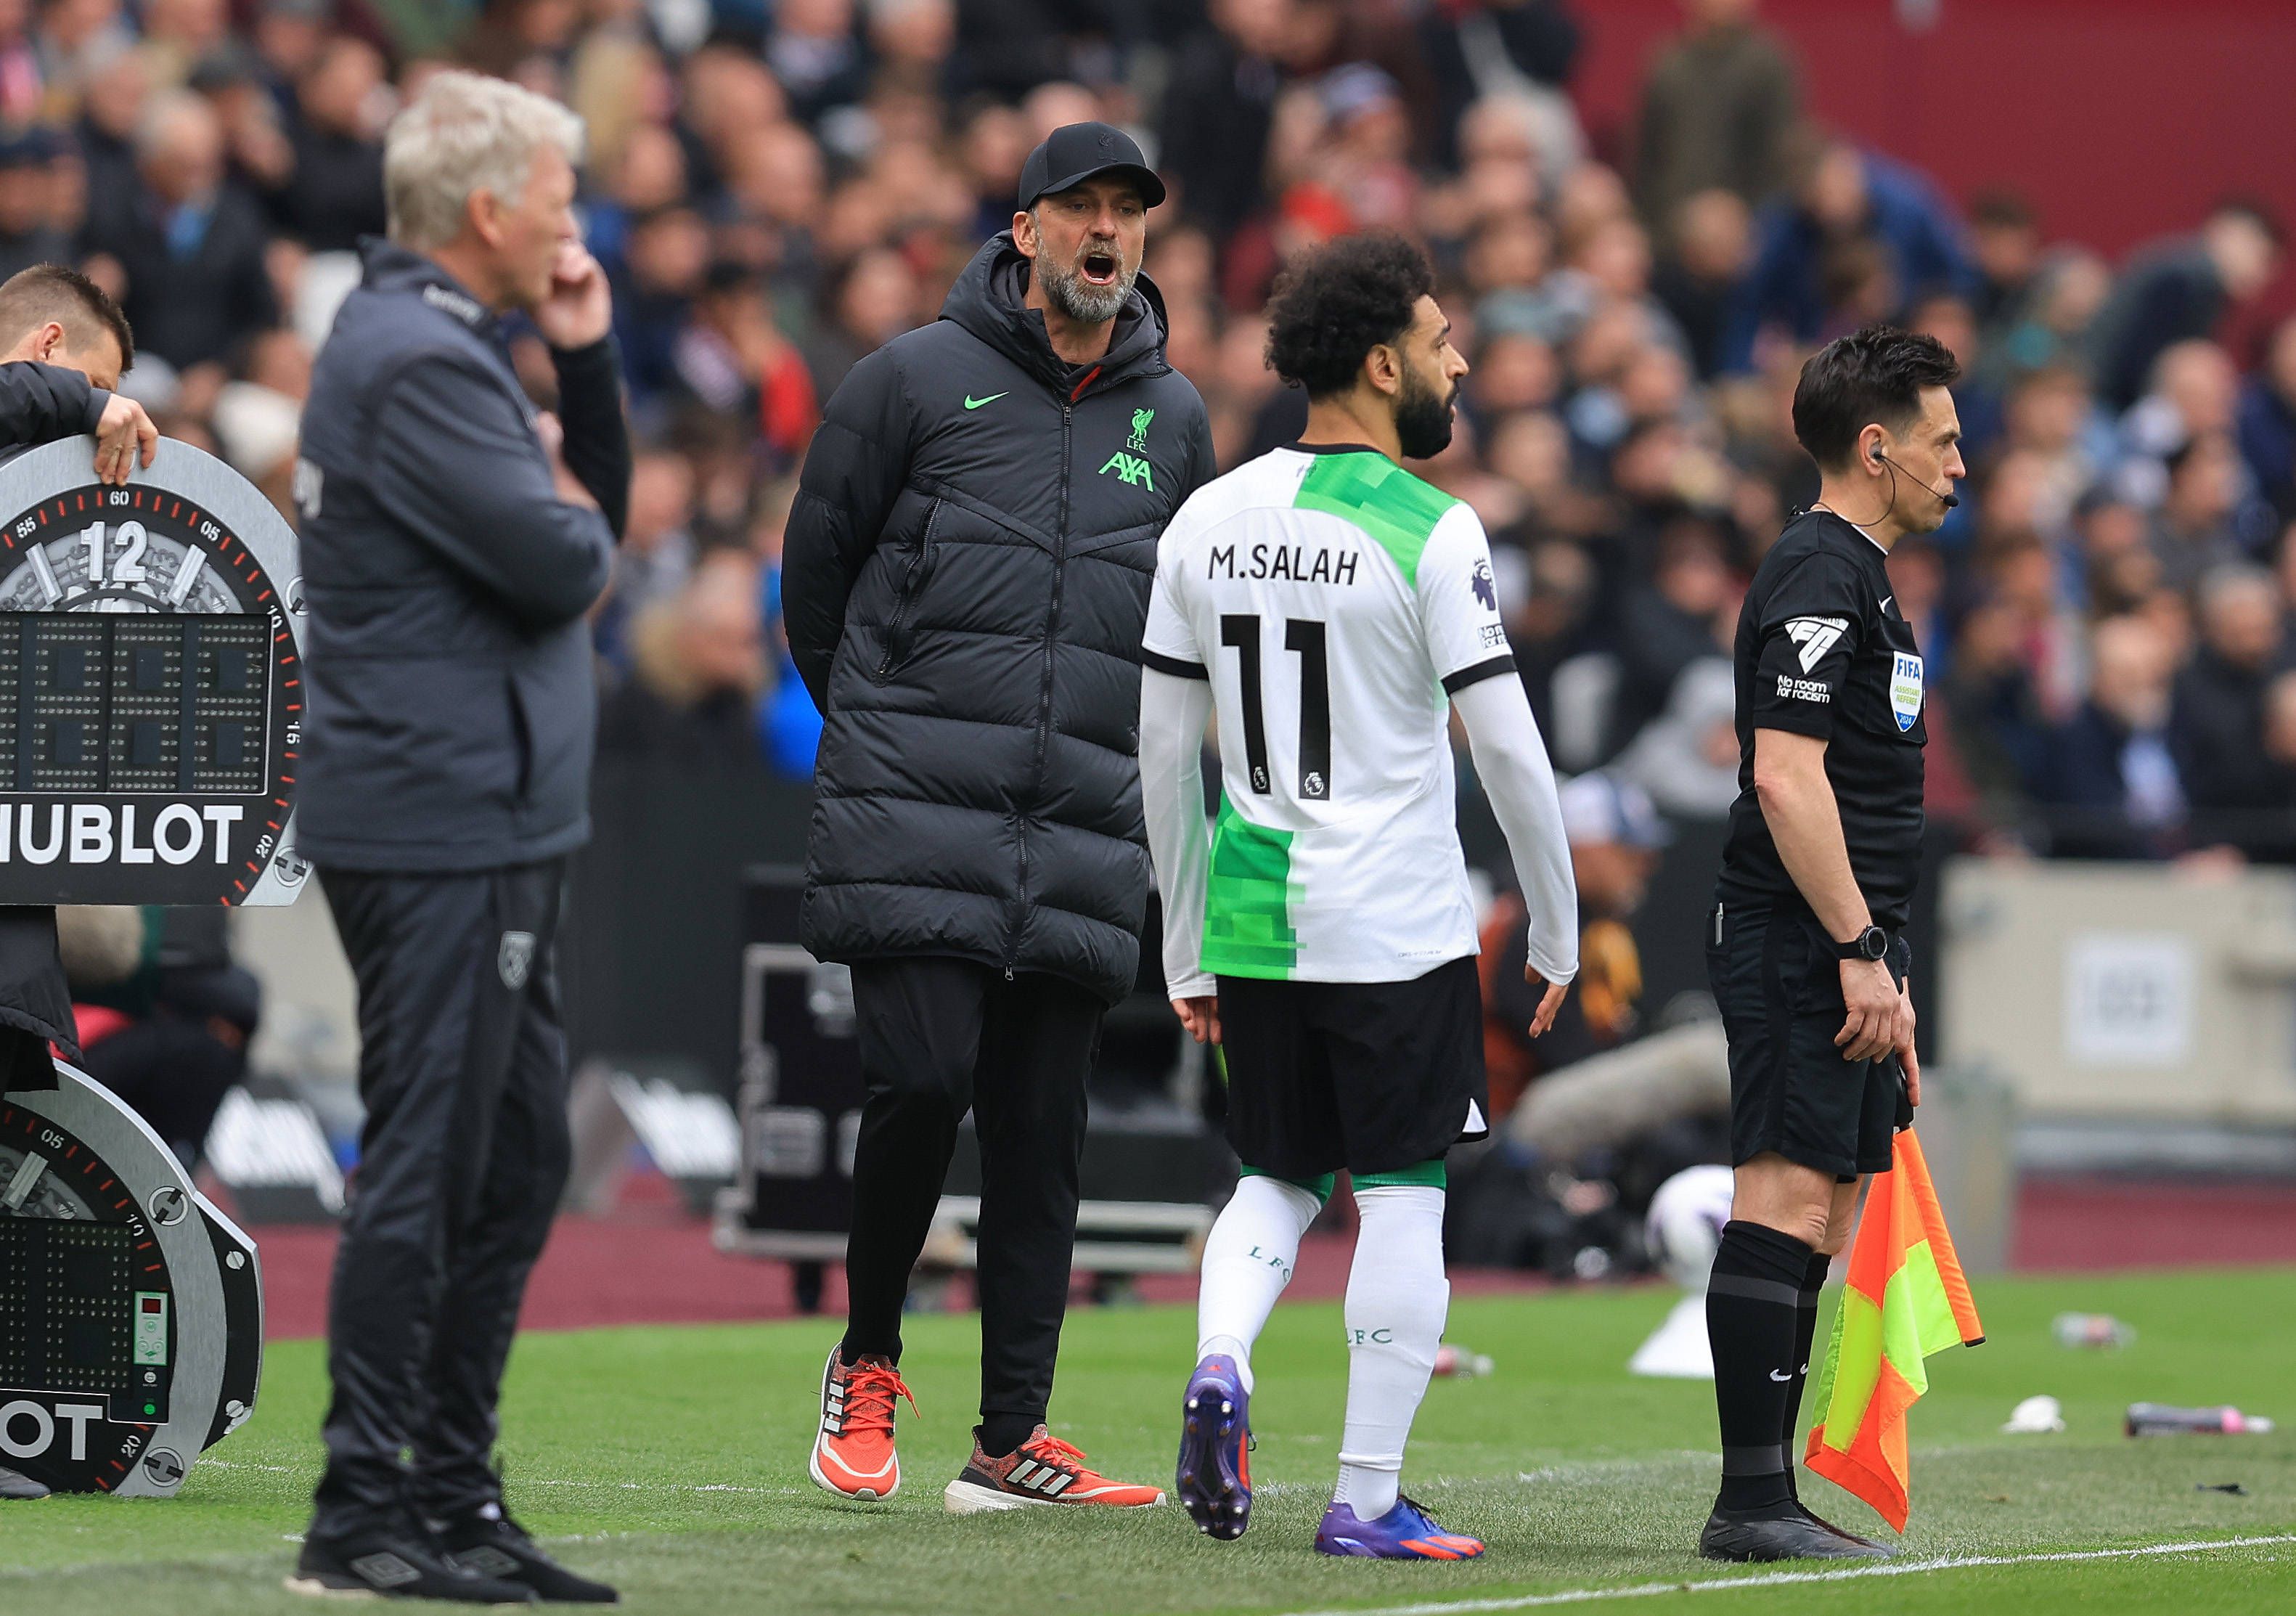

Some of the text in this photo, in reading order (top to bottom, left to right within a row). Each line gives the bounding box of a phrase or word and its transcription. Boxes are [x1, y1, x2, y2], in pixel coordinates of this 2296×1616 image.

[1098, 451, 1153, 492] AXA
[110, 491, 130, 506] 60
[16, 516, 37, 539] 55
[200, 520, 221, 542] 05
[80, 521, 147, 581] 12
[1208, 544, 1359, 586] M.SALAH
[1896, 657, 1921, 680] FIFA
[1776, 685, 1831, 703] for racism
[1777, 674, 1827, 693] No room
[1220, 614, 1331, 801] 11
[255, 834, 274, 859] 20
[41, 1129, 65, 1149] 05
[1347, 1329, 1392, 1344] FC
[120, 1435, 142, 1458] 20
